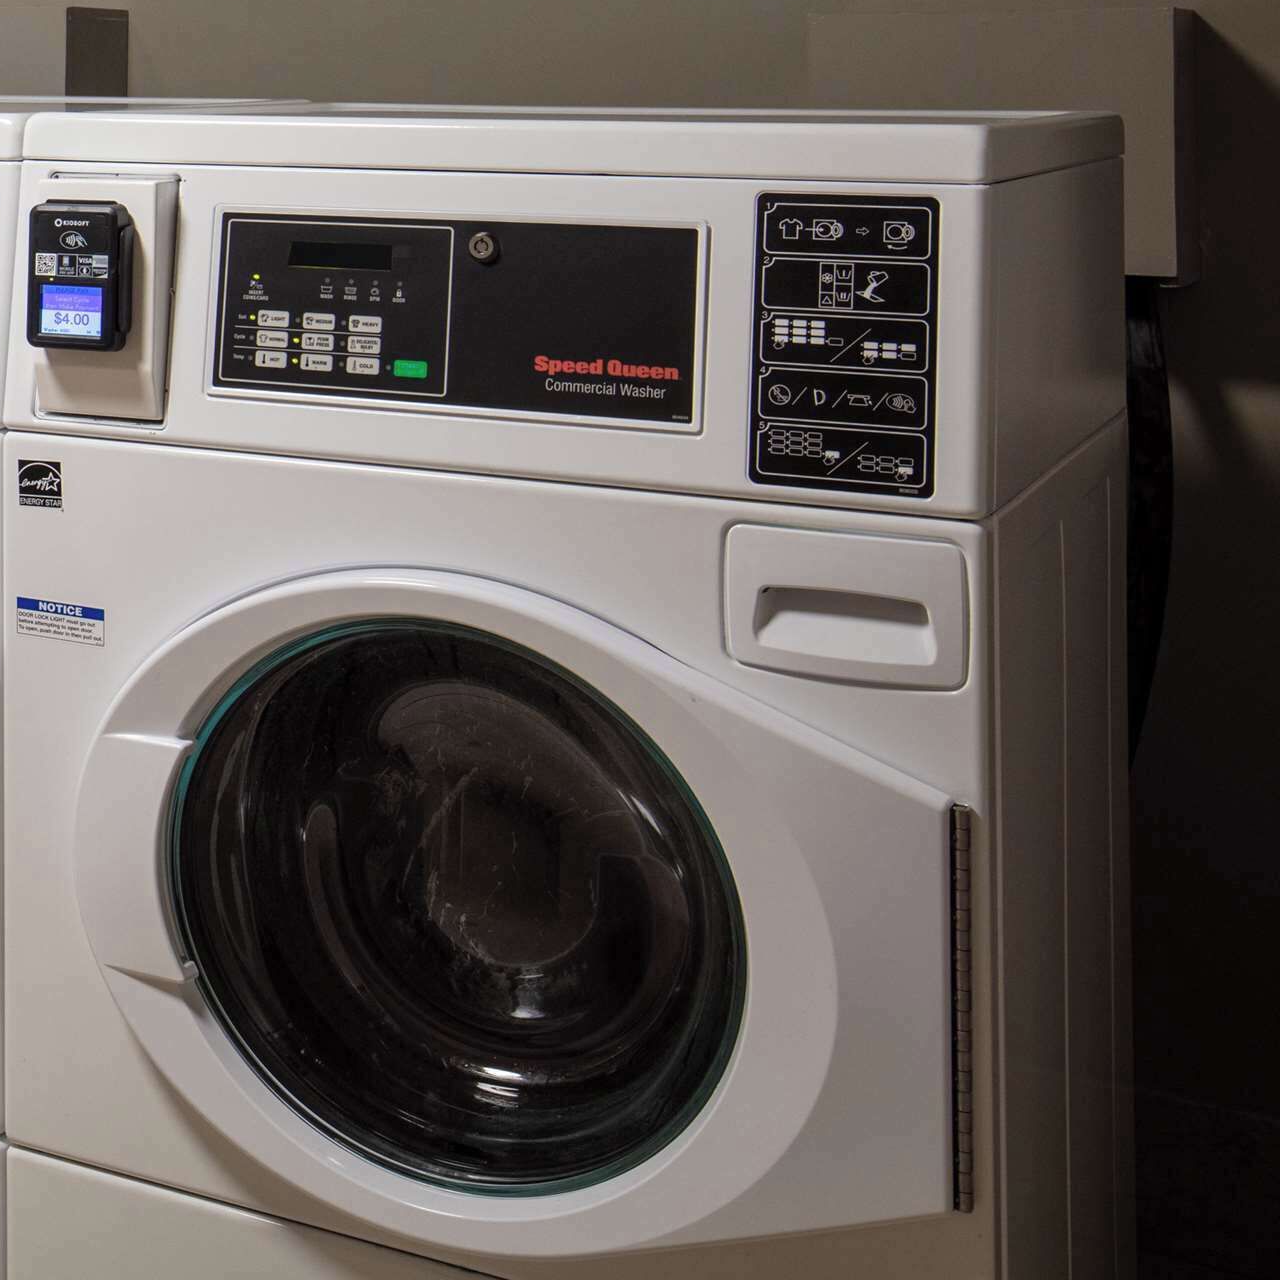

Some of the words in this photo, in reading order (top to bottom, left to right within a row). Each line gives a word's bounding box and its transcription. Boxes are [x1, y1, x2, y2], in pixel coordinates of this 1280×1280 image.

[54, 312, 89, 326] $4.00
[534, 355, 603, 375] Speed
[607, 359, 679, 380] Queen
[545, 377, 616, 396] Commercial
[619, 383, 667, 399] Washer
[20, 497, 44, 506] ENERGY
[45, 499, 62, 508] STAR
[39, 602, 83, 616] NOTICE
[35, 620, 60, 630] attempting
